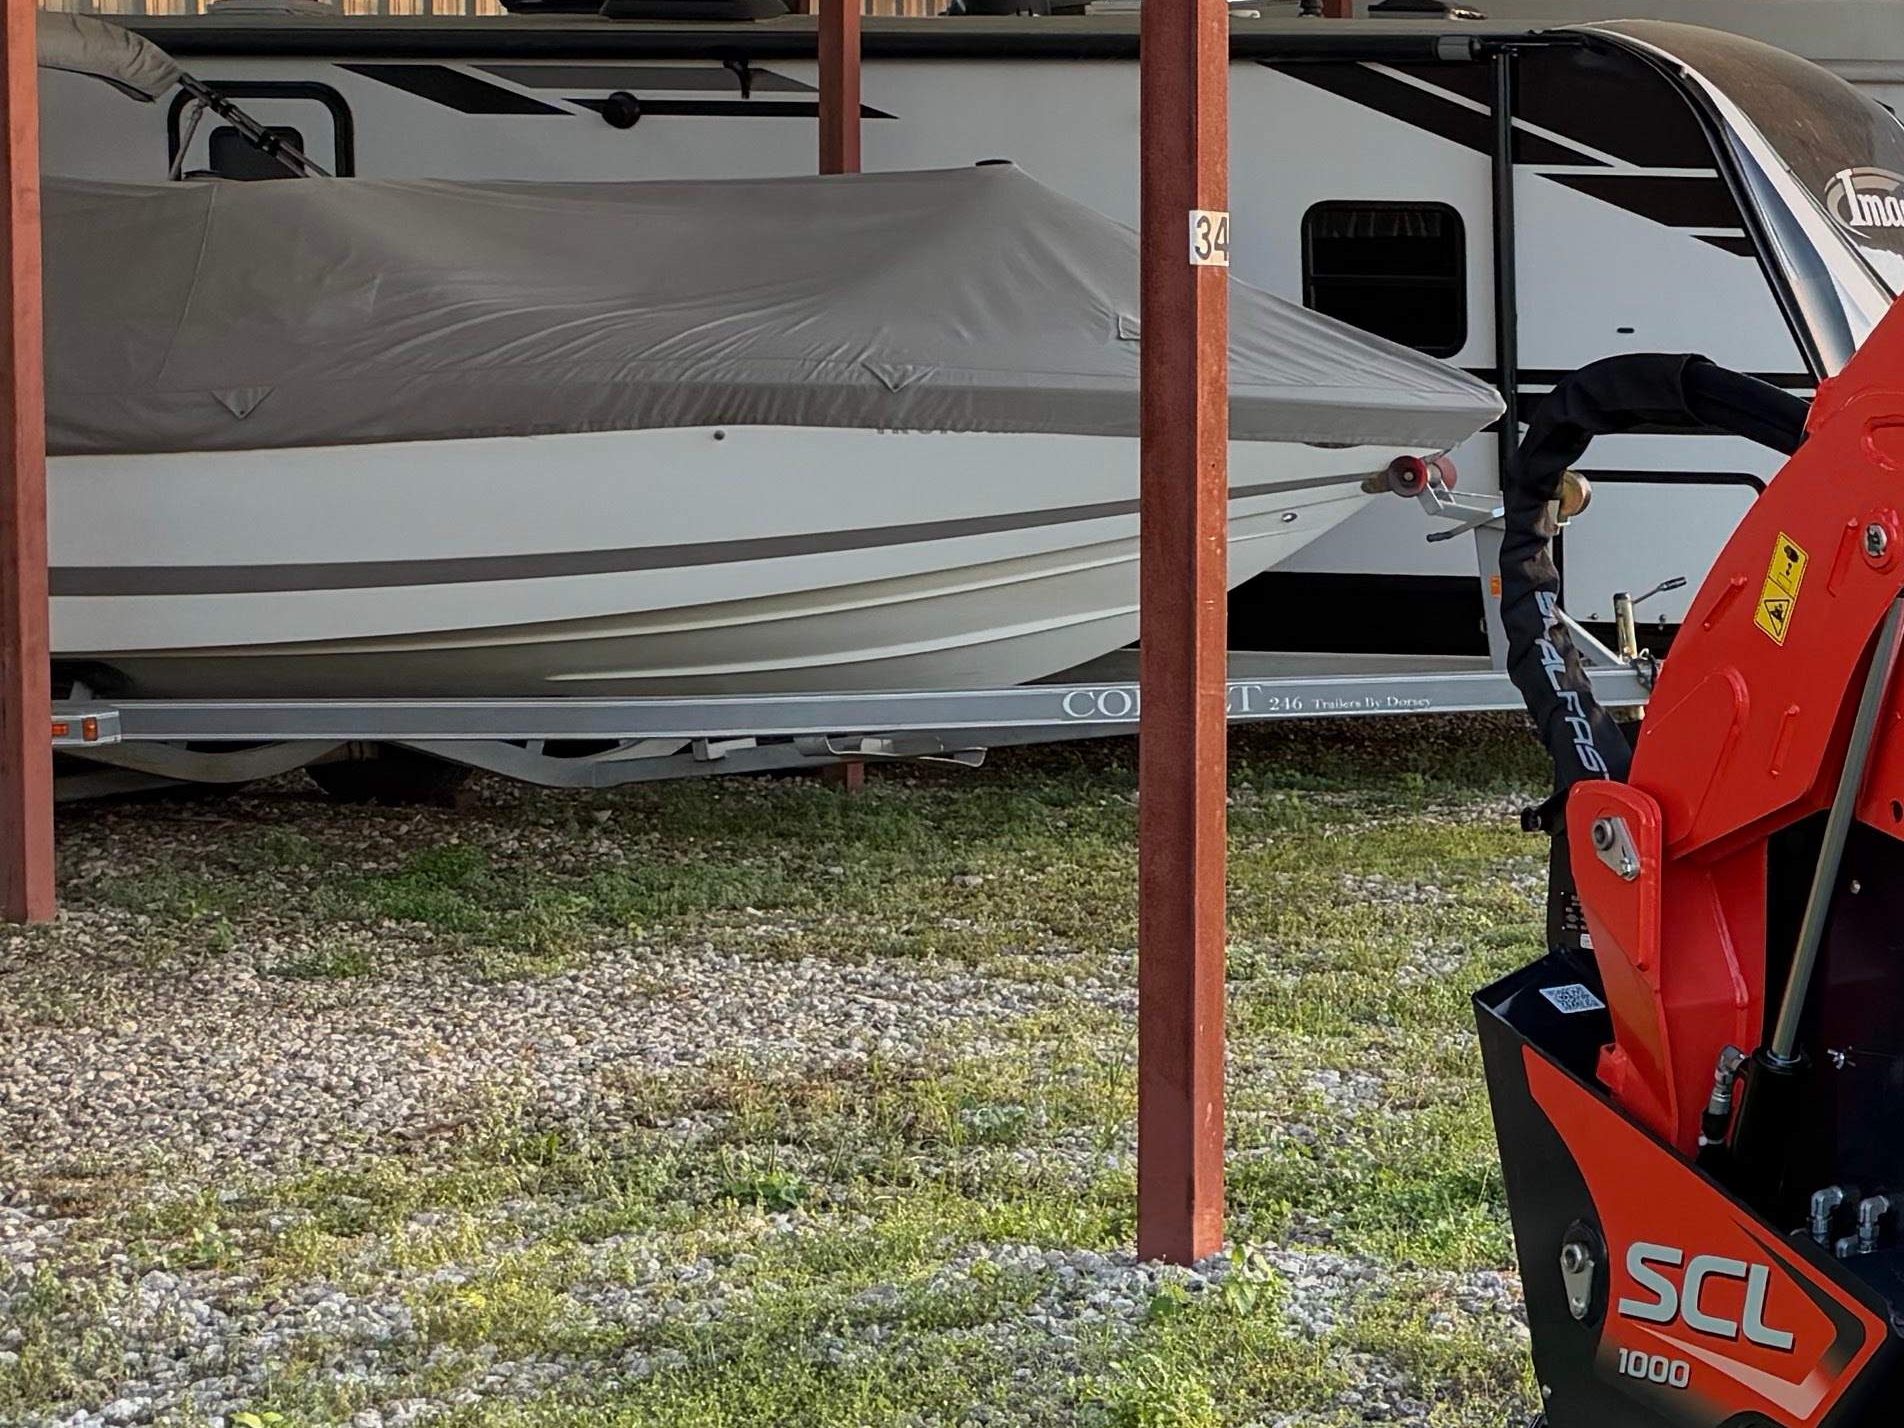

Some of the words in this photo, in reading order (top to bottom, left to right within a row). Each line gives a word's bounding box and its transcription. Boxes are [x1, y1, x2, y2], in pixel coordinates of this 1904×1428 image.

[1194, 215, 1231, 262] 34
[1269, 696, 1303, 711] 246
[1618, 1241, 1794, 1351] SCL
[1618, 1348, 1690, 1389] 1000
